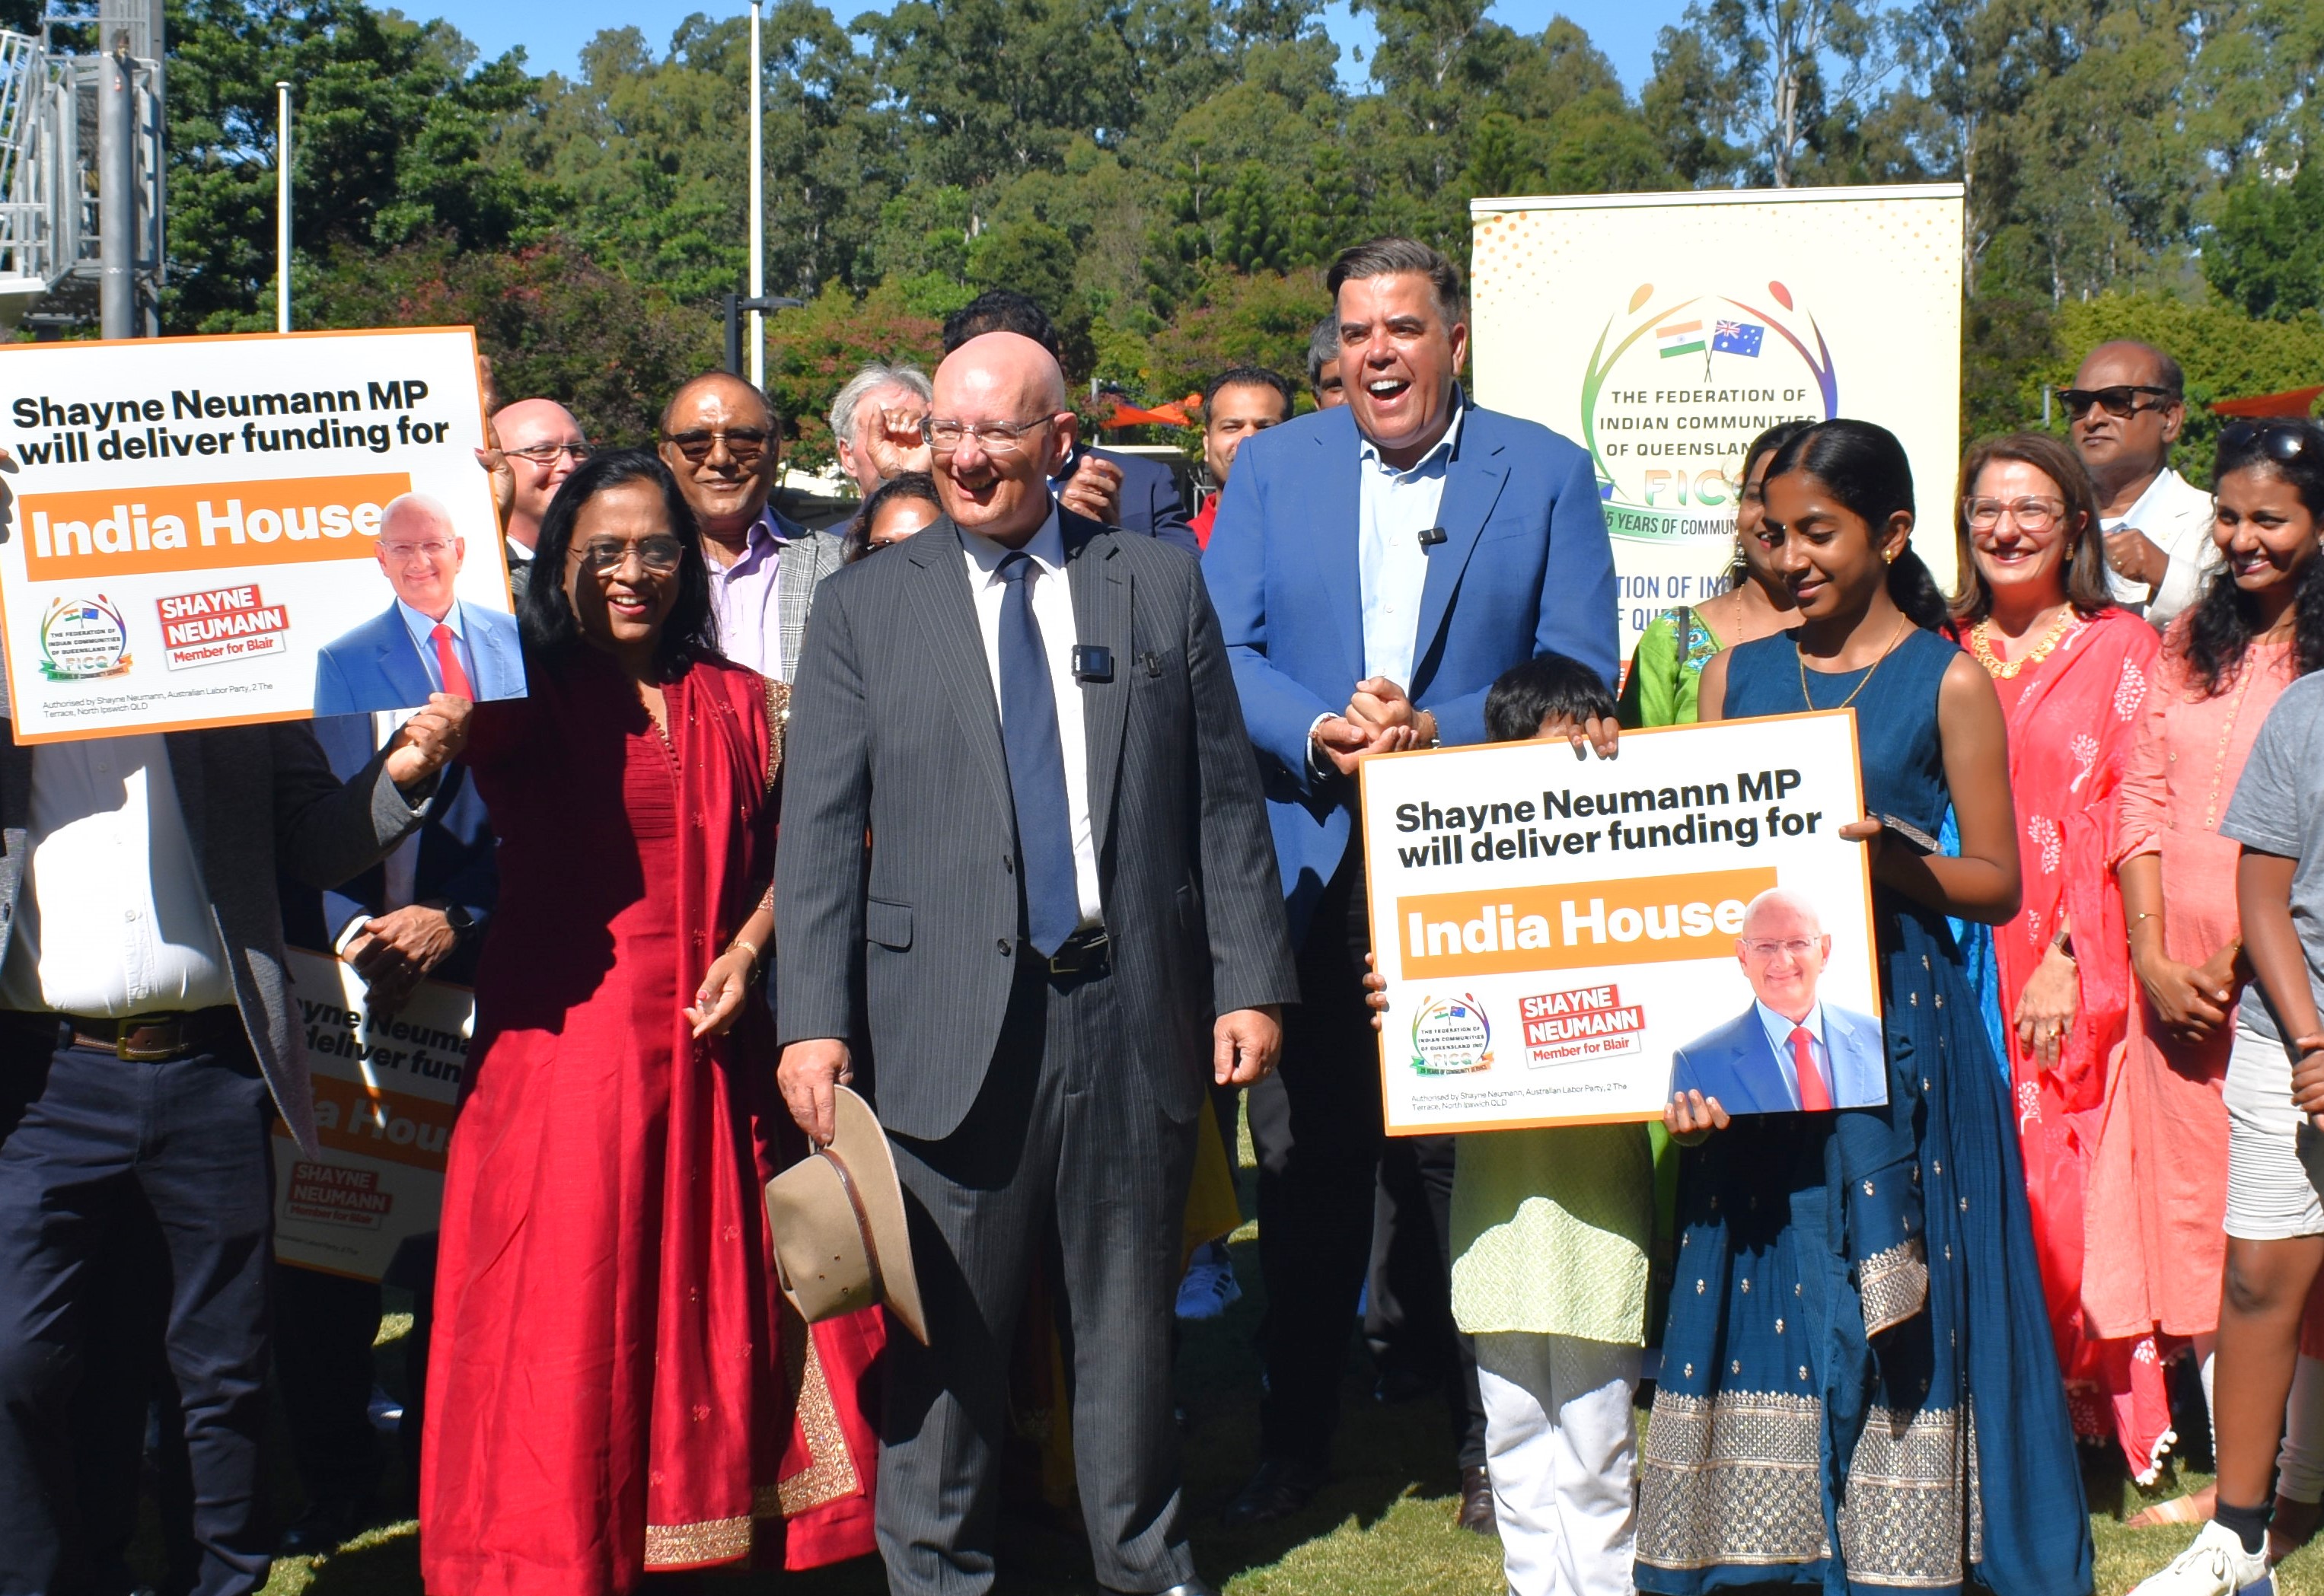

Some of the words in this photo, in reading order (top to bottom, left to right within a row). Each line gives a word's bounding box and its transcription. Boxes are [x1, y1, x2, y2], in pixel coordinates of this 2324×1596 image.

[12, 396, 165, 432] Shayne
[171, 389, 362, 420] Neumann
[367, 380, 429, 410] MP
[1611, 390, 1647, 403] THE
[1656, 389, 1775, 403] FEDERATION
[1784, 389, 1806, 402] OF
[1600, 417, 1669, 430] INDIAN
[16, 431, 90, 466] will
[97, 426, 235, 460] deliver
[241, 418, 391, 454] funding
[397, 415, 450, 445] for
[1606, 444, 1628, 457] OF
[1637, 443, 1751, 456] QUEENSLAN
[1644, 469, 1744, 506] FIC
[31, 503, 188, 558] India
[196, 499, 384, 547] House
[1618, 512, 1659, 533] YEARS
[1662, 518, 1678, 534] OF
[1681, 518, 1737, 535] COMMUN
[1615, 576, 1659, 598] TION
[1667, 576, 1692, 598] OF
[161, 587, 255, 619] SHAYNE
[167, 608, 282, 645] NEUMANN
[65, 655, 108, 671] FICQ
[174, 647, 224, 663] Member
[226, 642, 244, 655] for
[247, 637, 274, 651] Blair
[43, 698, 85, 709] Authorised
[86, 698, 96, 706] by
[97, 696, 126, 705] Shayne
[126, 693, 167, 702] Neumann,
[167, 689, 205, 698] Australian
[229, 685, 251, 693] Party,
[100, 706, 130, 714] Ipswich
[1395, 801, 1535, 834] Shayne
[1542, 782, 1729, 820] Neumann
[1737, 769, 1802, 803] MP
[1398, 834, 1463, 868] will
[1471, 827, 1602, 863] deliver
[1608, 812, 1759, 851] funding
[1765, 806, 1822, 837] for
[1407, 903, 1551, 957] India
[1560, 897, 1749, 947] House
[1523, 987, 1613, 1018] SHAYNE
[296, 998, 361, 1029] yne
[365, 1010, 471, 1055] Neuma
[1529, 1008, 1639, 1044] NEUMANN
[1433, 1053, 1472, 1066] FICQ
[1533, 1046, 1581, 1061] Member
[1583, 1042, 1601, 1053] for
[1602, 1037, 1630, 1051] Blair
[410, 1050, 463, 1084] fun
[1412, 1094, 1449, 1102] Authorised
[1450, 1093, 1459, 1101] by
[1606, 1083, 1611, 1091] 2
[346, 1097, 451, 1153] Hou
[296, 1163, 371, 1189] SHAYNE
[292, 1183, 386, 1212] NEUMANN
